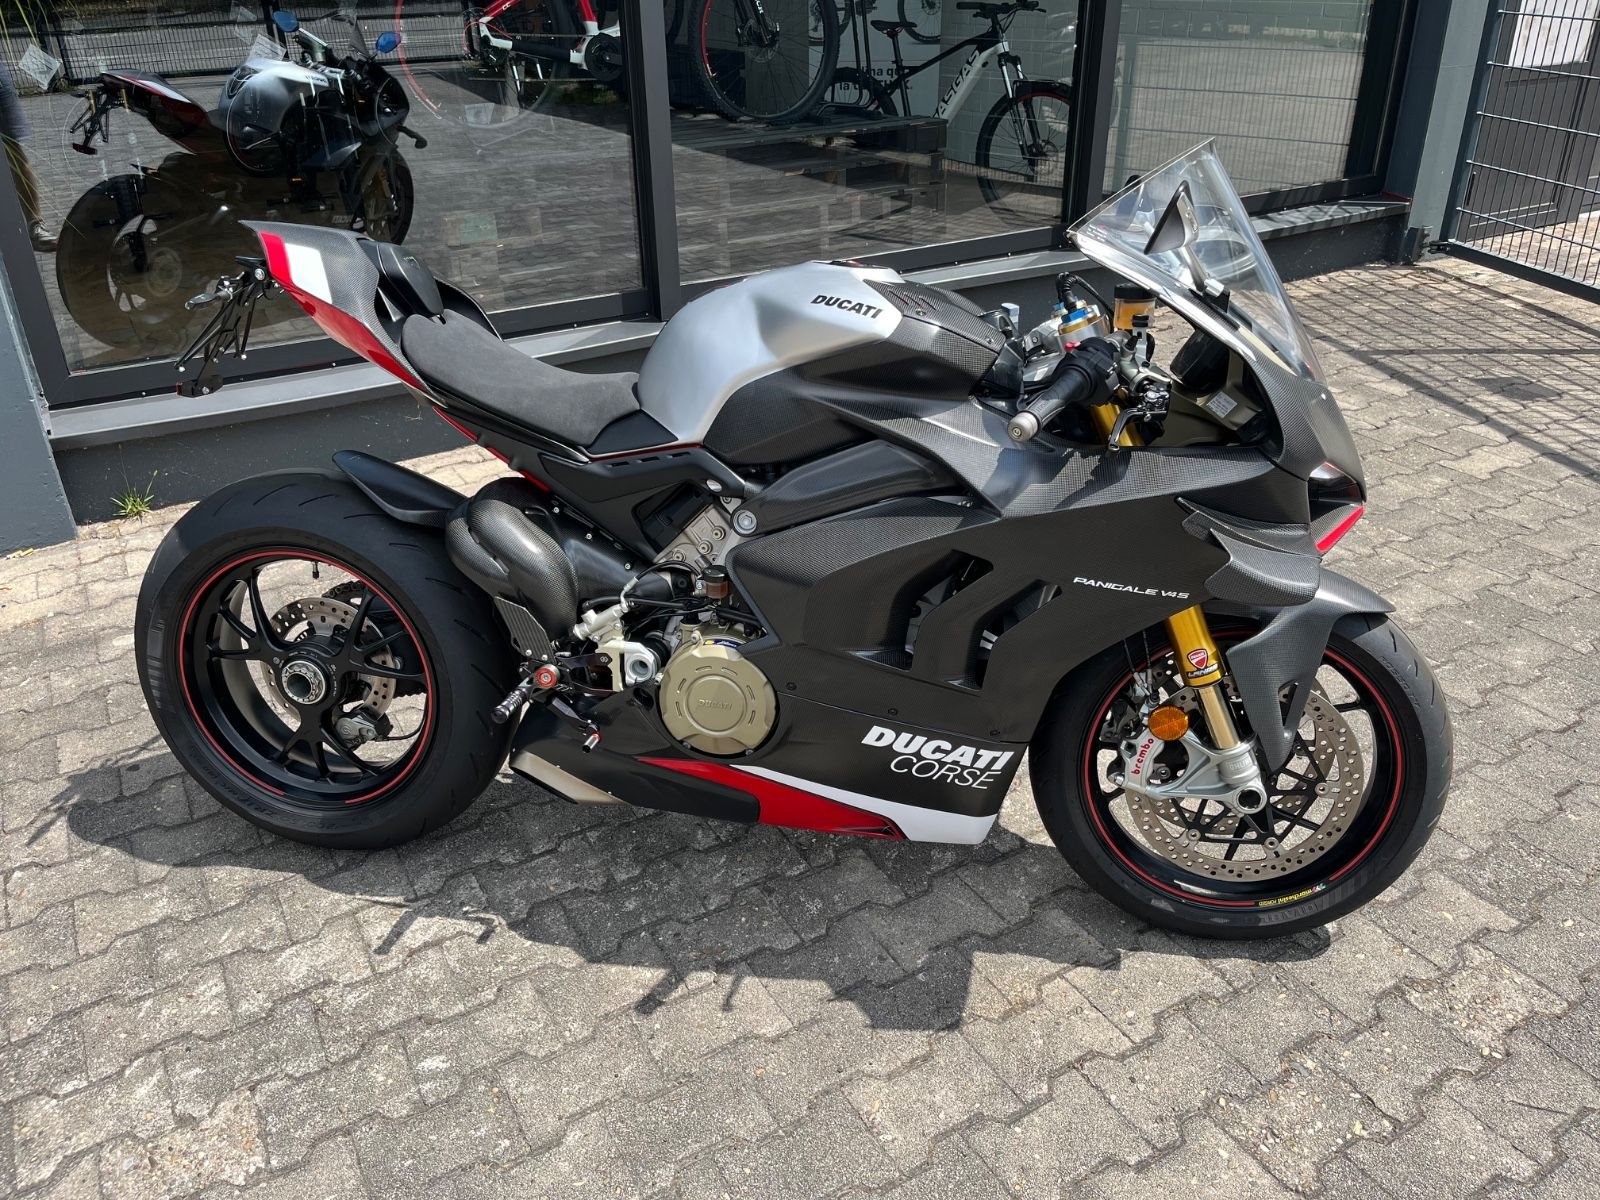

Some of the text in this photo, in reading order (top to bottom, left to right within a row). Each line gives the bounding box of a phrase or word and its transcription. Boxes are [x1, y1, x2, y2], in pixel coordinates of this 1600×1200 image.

[810, 294, 883, 319] DUCATI
[1073, 577, 1190, 599] PANIGALE V4S
[861, 725, 1015, 770] DUCATI
[1131, 738, 1154, 775] brembo
[890, 755, 1002, 790] CORSE
